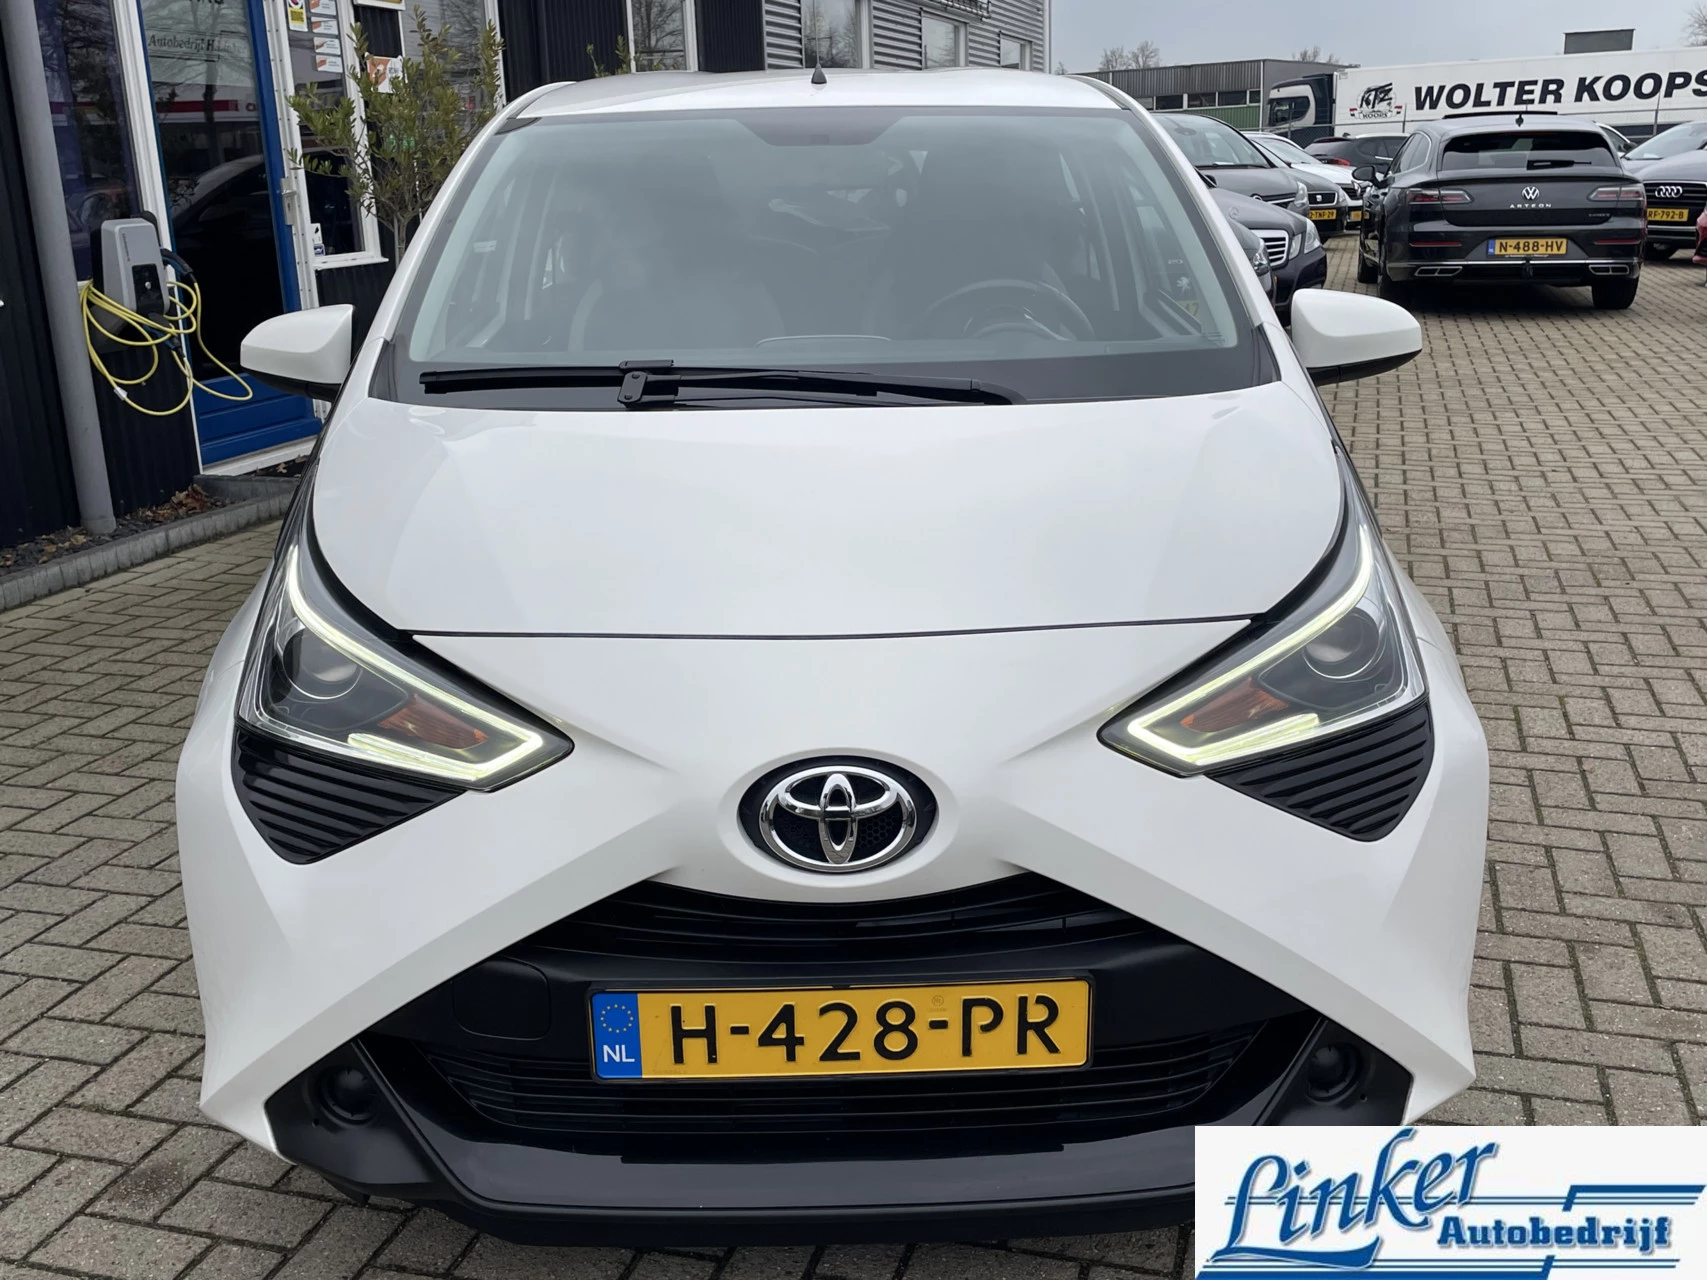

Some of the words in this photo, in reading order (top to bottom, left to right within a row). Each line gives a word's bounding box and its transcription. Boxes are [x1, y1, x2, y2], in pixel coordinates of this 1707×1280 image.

[1414, 79, 1565, 111] WOLTER
[1499, 240, 1564, 253] N-488-HV
[602, 1044, 636, 1064] NL
[670, 993, 1062, 1065] H-428-PR
